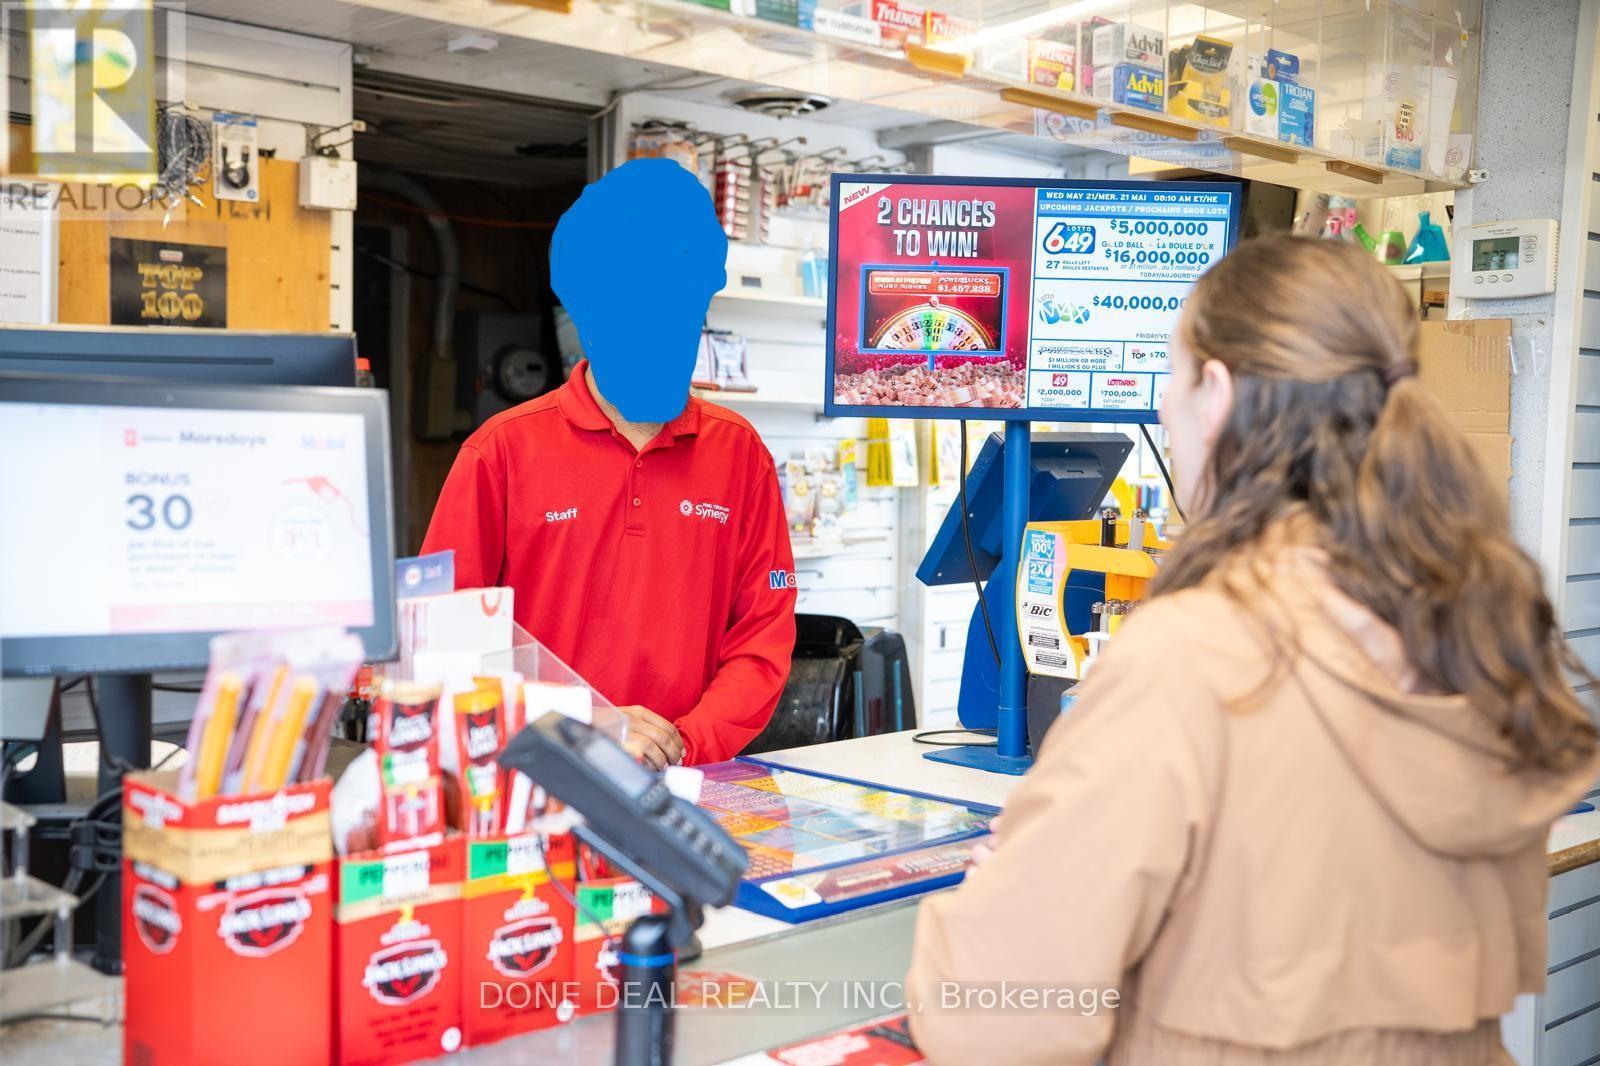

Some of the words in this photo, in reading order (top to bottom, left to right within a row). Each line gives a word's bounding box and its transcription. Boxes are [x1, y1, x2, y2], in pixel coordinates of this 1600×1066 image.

[876, 3, 922, 27] TYLENOL
[830, 20, 874, 34] customer
[1127, 32, 1163, 56] Advil
[1126, 71, 1163, 97] Advil
[1285, 83, 1313, 100] TROJAN
[843, 185, 871, 205] NEW
[1046, 191, 1064, 199] WED
[1066, 192, 1084, 200] MAY
[1086, 193, 1118, 201] 21/MER.
[1120, 193, 1130, 201] 21
[1132, 194, 1147, 202] MAI
[1179, 195, 1191, 203] AM
[1193, 195, 1218, 204] ET/HE
[877, 196, 892, 225] 2
[897, 198, 996, 227] CHANCES
[1040, 203, 1082, 212] UPCOMING
[1084, 204, 1127, 213] JACKPOTS
[1134, 206, 1181, 215] PROCHAINS
[1183, 207, 1205, 215] GROS
[1206, 207, 1227, 216] LOTS
[1110, 219, 1208, 237] $5,000,000
[893, 229, 920, 256] TO
[927, 230, 978, 257] WIN!
[1126, 241, 1144, 249] BALL
[1157, 242, 1167, 250] LA
[1168, 242, 1192, 250] BOULE
[1046, 261, 1060, 269] 27
[1105, 250, 1210, 266] $16,000,000
[138, 264, 204, 290] TOP
[140, 291, 204, 320] 100
[125, 473, 191, 486] BONUS
[126, 494, 193, 530] 30
[545, 507, 578, 522] Staff
[695, 504, 729, 525] Synergy
[1030, 563, 1045, 576] 2X
